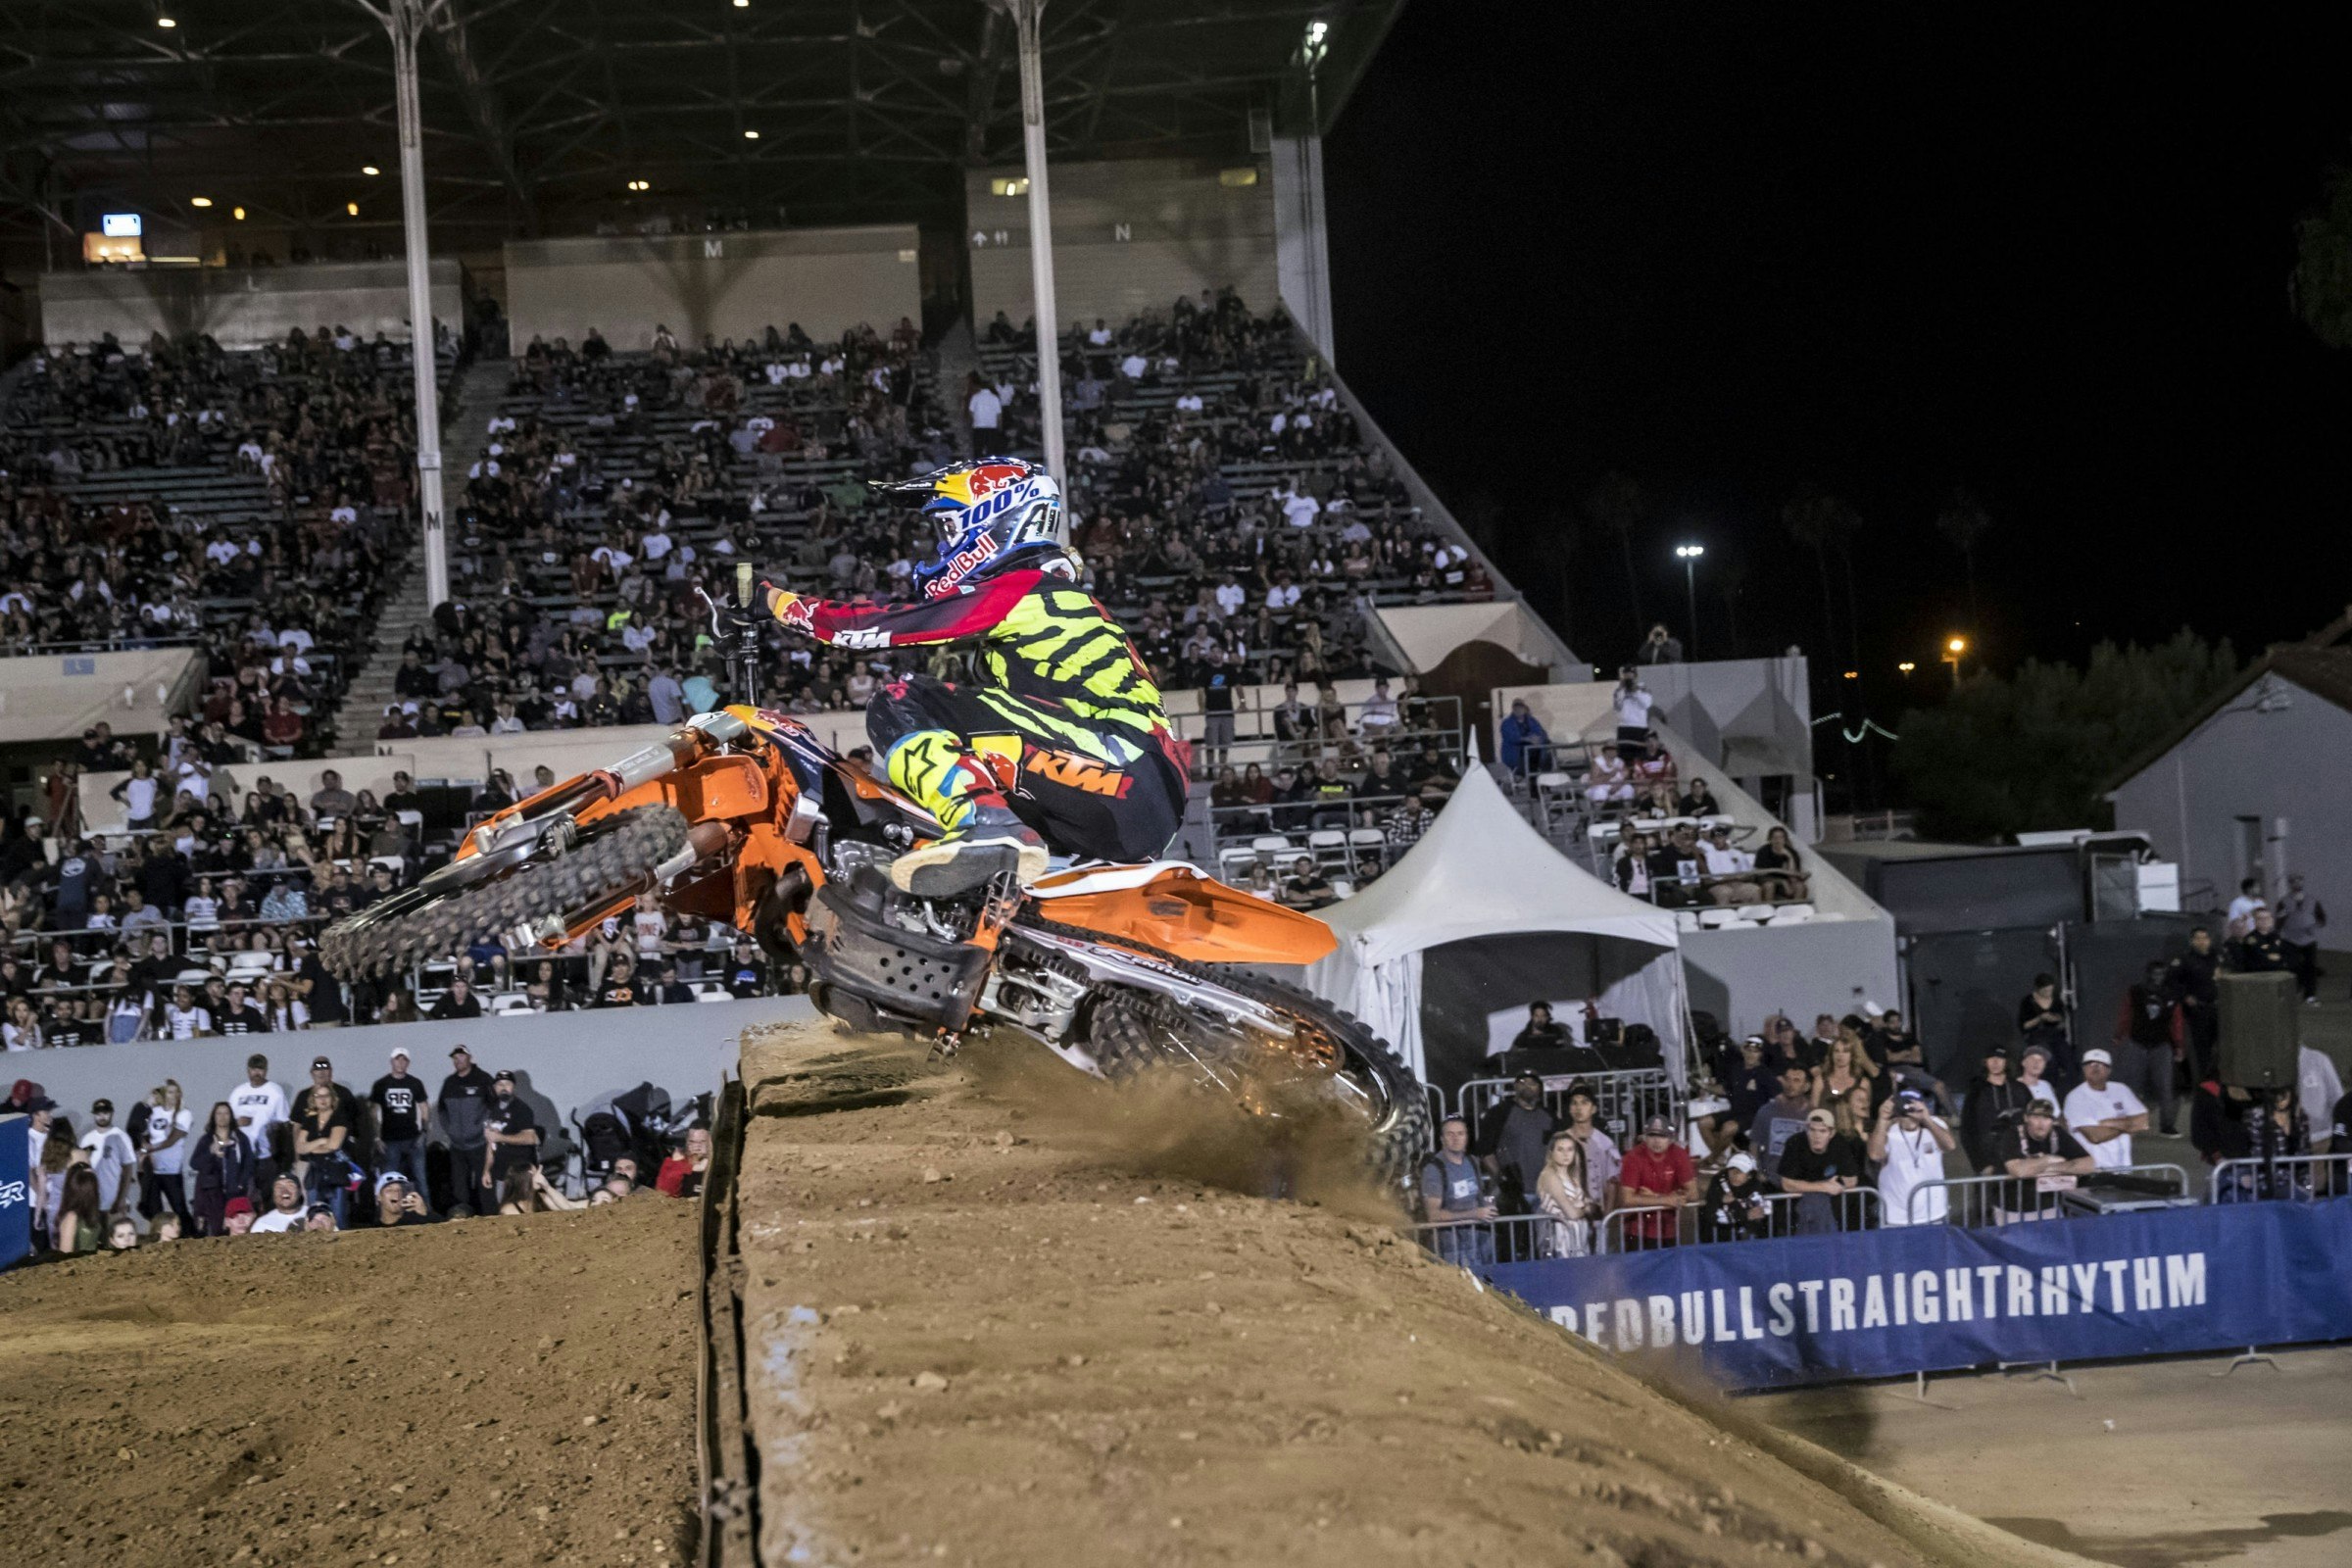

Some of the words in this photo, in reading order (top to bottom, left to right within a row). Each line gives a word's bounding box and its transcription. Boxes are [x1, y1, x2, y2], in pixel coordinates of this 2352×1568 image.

[705, 240, 723, 258] M
[1115, 223, 1131, 241] N
[426, 511, 440, 530] M
[958, 480, 1040, 530] 100%
[924, 564, 960, 598] Red
[955, 533, 999, 575] Bull
[831, 626, 892, 649] KTM
[1026, 749, 1123, 797] KTM
[1089, 947, 1202, 986] RENTHAL
[1535, 1252, 2207, 1352] REDBULLSTRAIGHTRHYTHM
